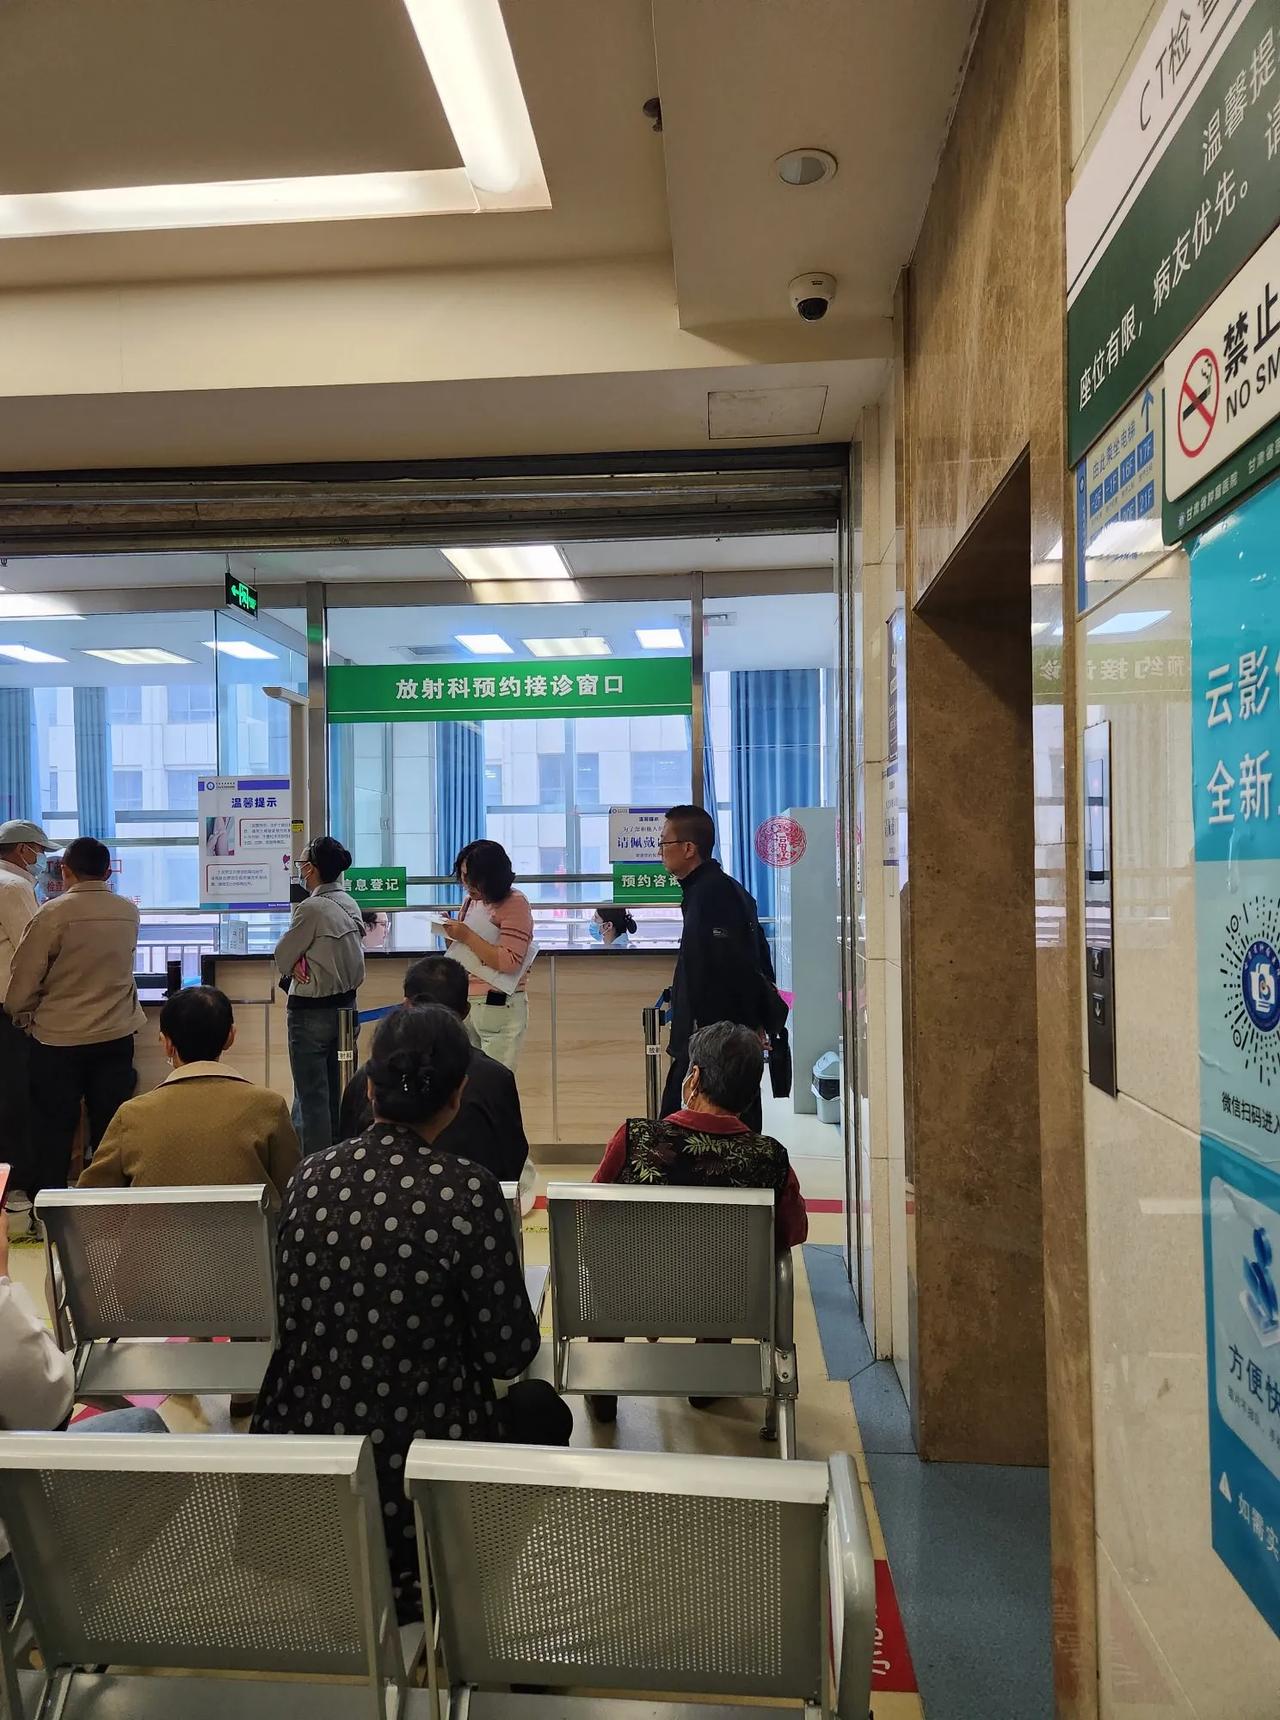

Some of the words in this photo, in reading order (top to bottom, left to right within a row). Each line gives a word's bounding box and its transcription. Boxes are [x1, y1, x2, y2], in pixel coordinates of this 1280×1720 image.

[1202, 26, 1280, 176] 温馨提
[1223, 282, 1280, 384] 禁止
[1226, 379, 1250, 424] NO
[395, 674, 625, 701] 放射科预约接诊窗口
[1206, 645, 1280, 728] 云影
[231, 797, 277, 808] 温馨提示
[1207, 750, 1280, 825] 全新
[617, 836, 661, 848] 请佩戴
[344, 878, 399, 892] 信息登记
